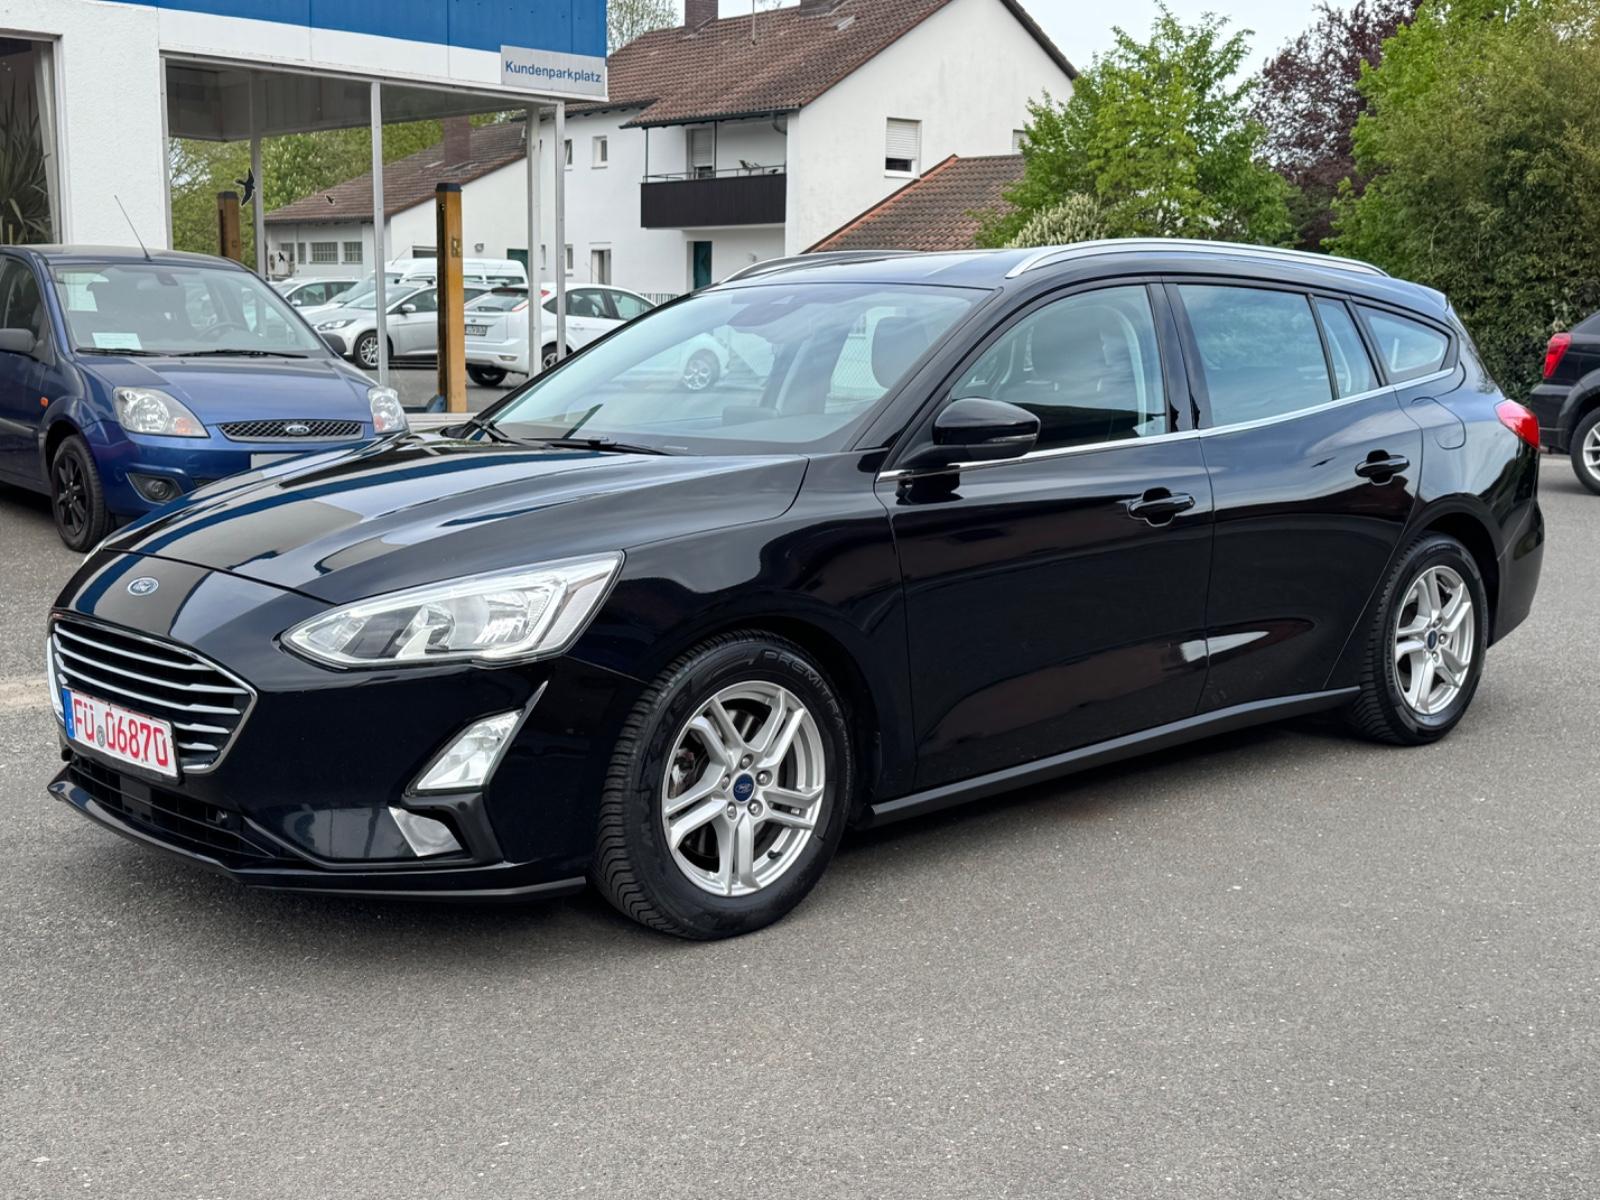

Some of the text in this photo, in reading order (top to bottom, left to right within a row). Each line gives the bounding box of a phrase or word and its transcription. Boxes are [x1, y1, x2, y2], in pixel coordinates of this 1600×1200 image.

[505, 60, 602, 83] Kundenparkplatz
[73, 698, 169, 767] FÜ 06870
